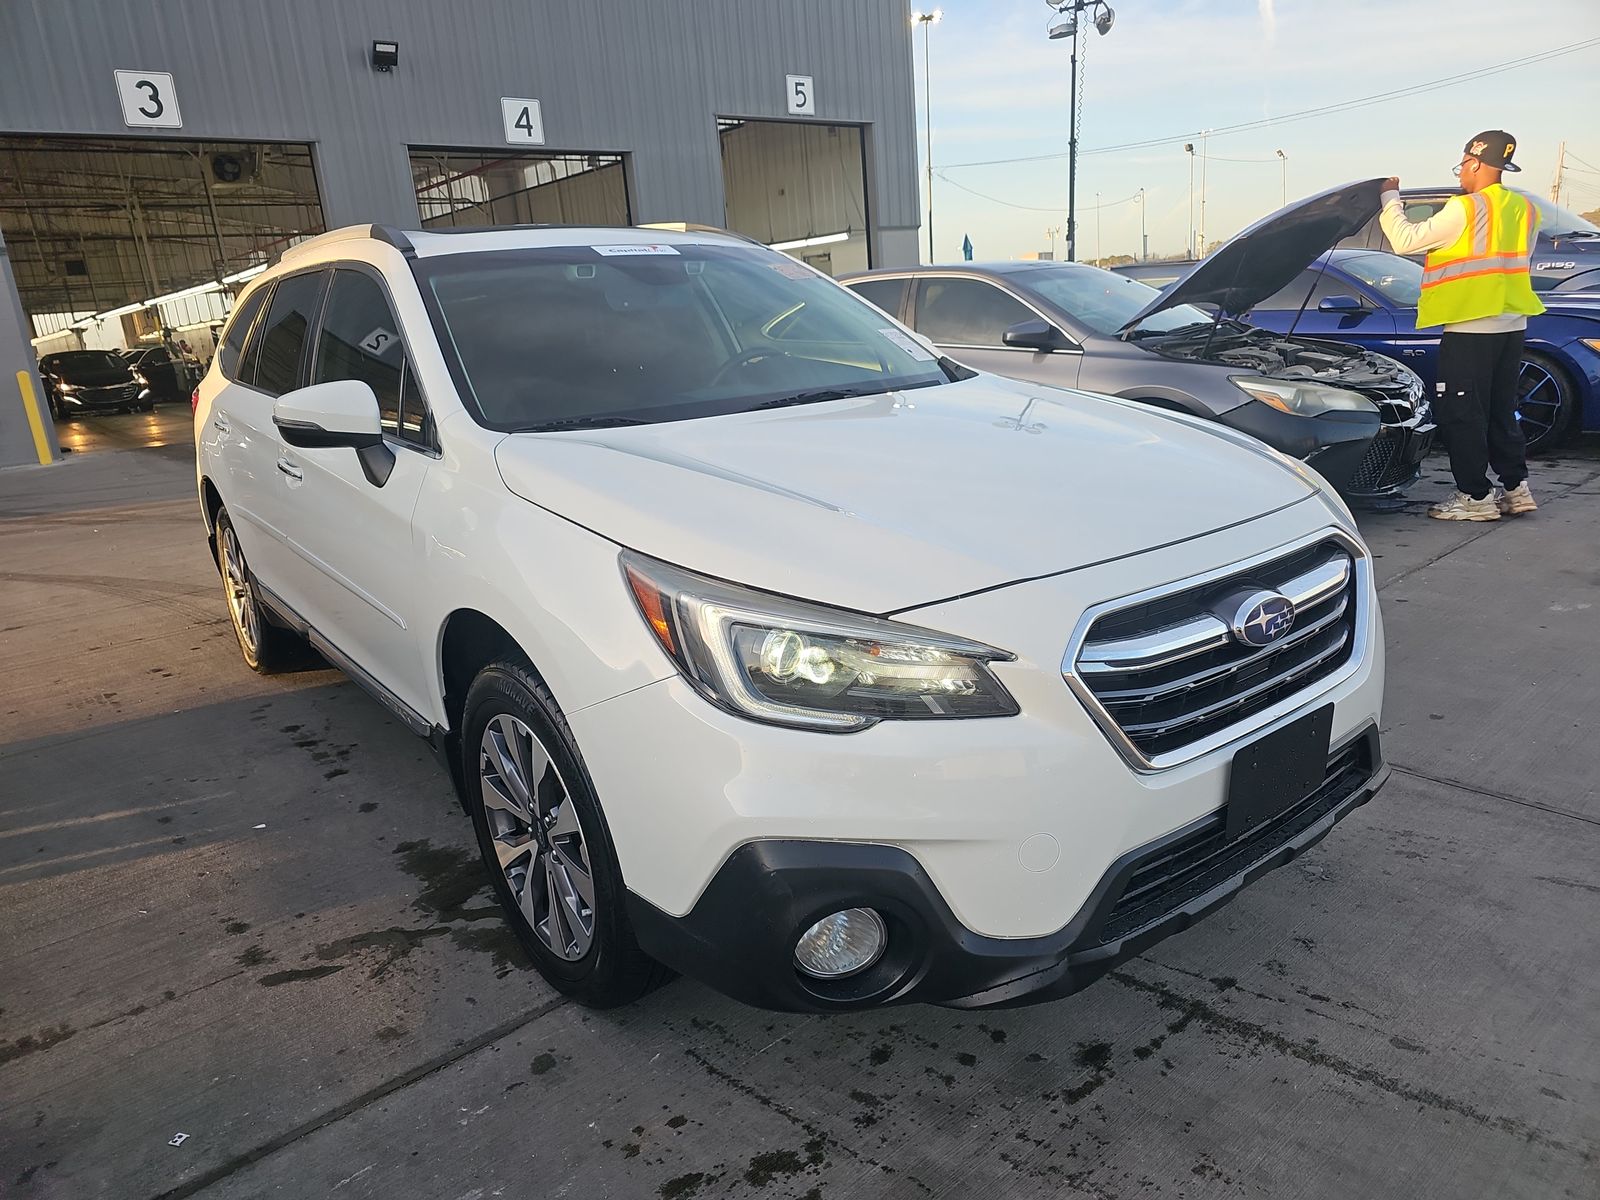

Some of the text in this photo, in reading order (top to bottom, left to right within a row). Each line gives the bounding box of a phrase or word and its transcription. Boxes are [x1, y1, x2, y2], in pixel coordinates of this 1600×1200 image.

[135, 80, 164, 119] 3
[794, 82, 807, 108] 5
[514, 106, 534, 137] 4
[1503, 143, 1515, 158] P
